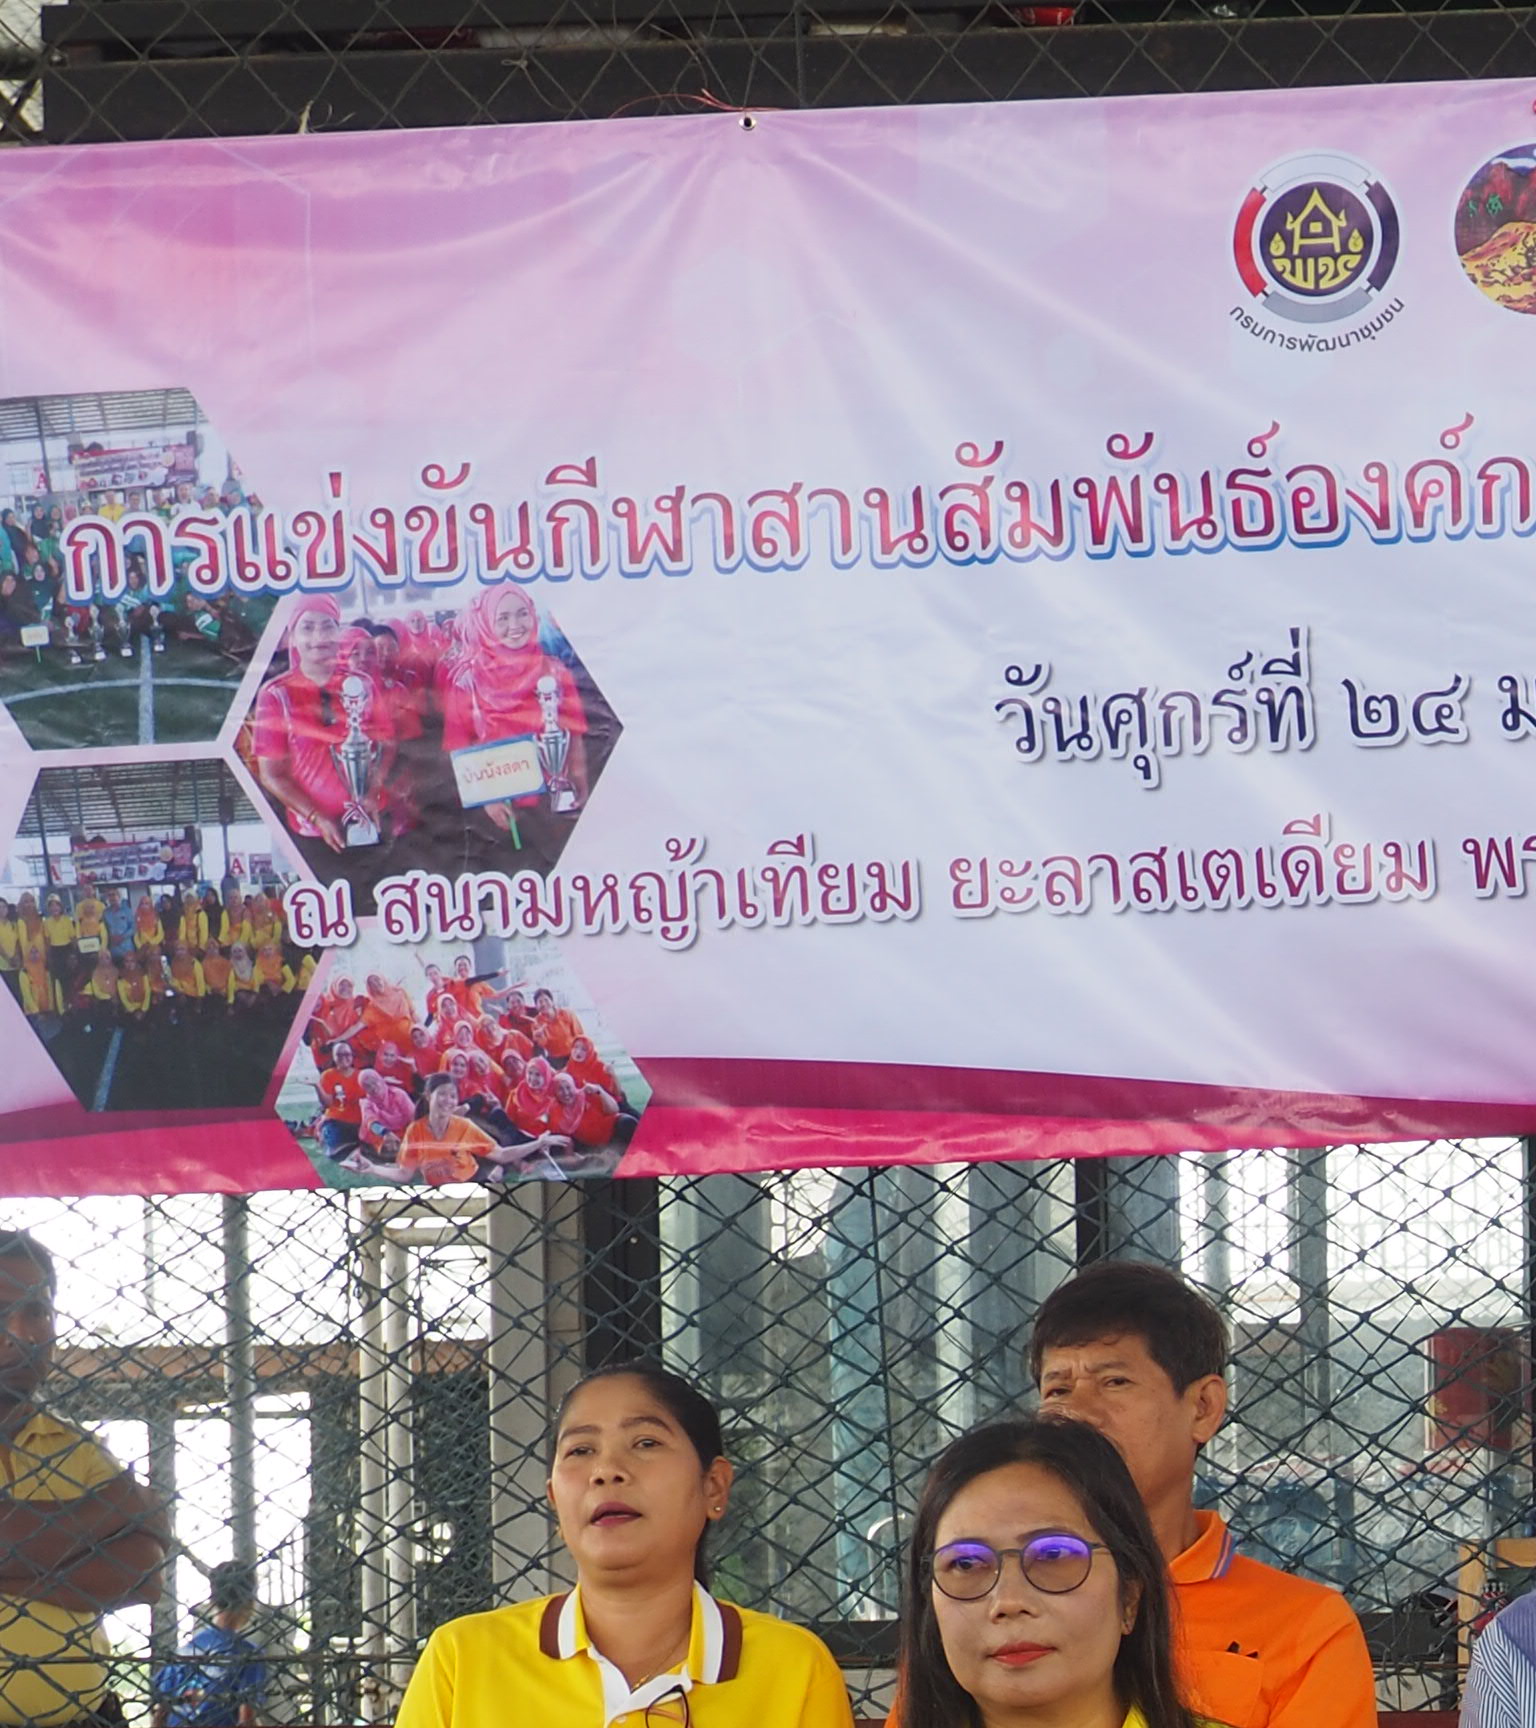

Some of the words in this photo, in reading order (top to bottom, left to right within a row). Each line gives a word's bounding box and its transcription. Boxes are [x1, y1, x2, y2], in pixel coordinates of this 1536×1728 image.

[1230, 297, 1405, 352] กรมการพัฒนาชุมชน
[997, 624, 1308, 780] วันศุกร์ที่
[1343, 676, 1467, 738] ๒๔
[290, 884, 348, 940] ณ
[382, 832, 912, 942] สนามหญ้าเทียม
[951, 815, 1429, 910] ยะลาสเตเดียม
